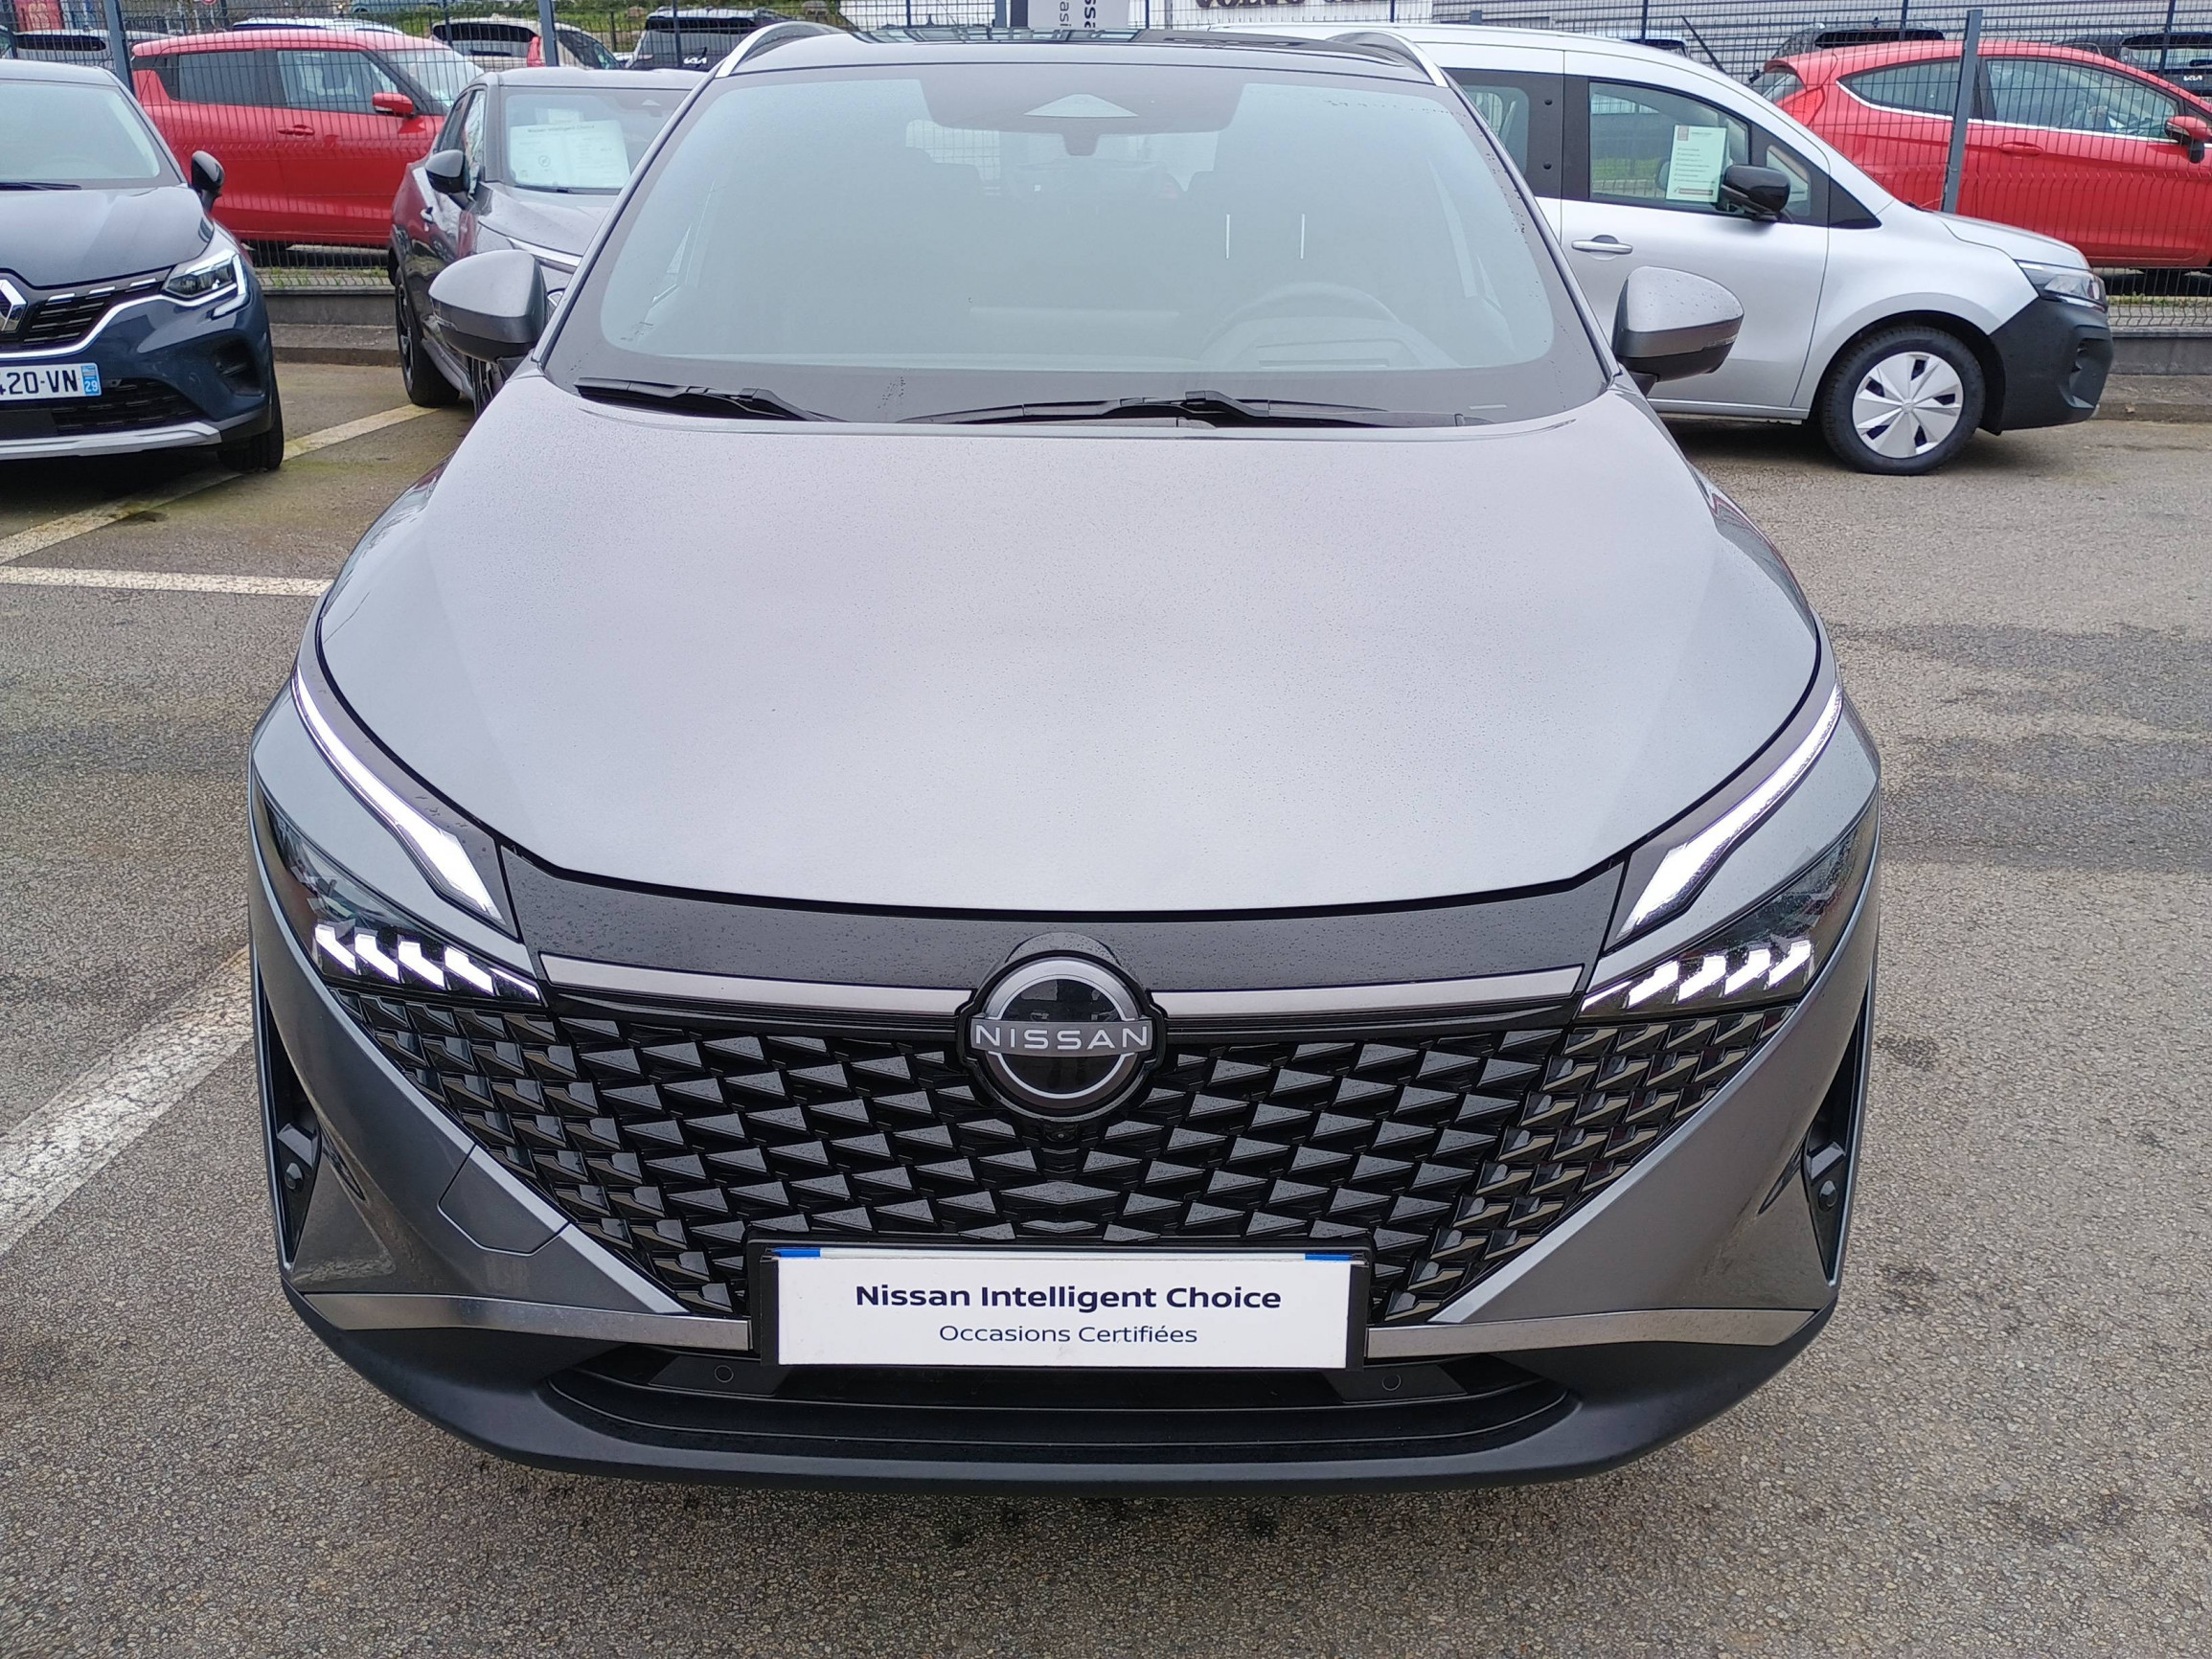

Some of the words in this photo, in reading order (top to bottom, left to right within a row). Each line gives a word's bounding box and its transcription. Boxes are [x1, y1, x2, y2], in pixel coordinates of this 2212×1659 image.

[84, 380, 99, 392] 29
[975, 1025, 1148, 1050] NISSAN
[856, 1284, 970, 1307] Nissan
[981, 1285, 1156, 1313] Intelligent
[1166, 1286, 1282, 1308] Choice
[939, 1326, 1071, 1342] Occasions
[1078, 1326, 1197, 1343] Certifiées
